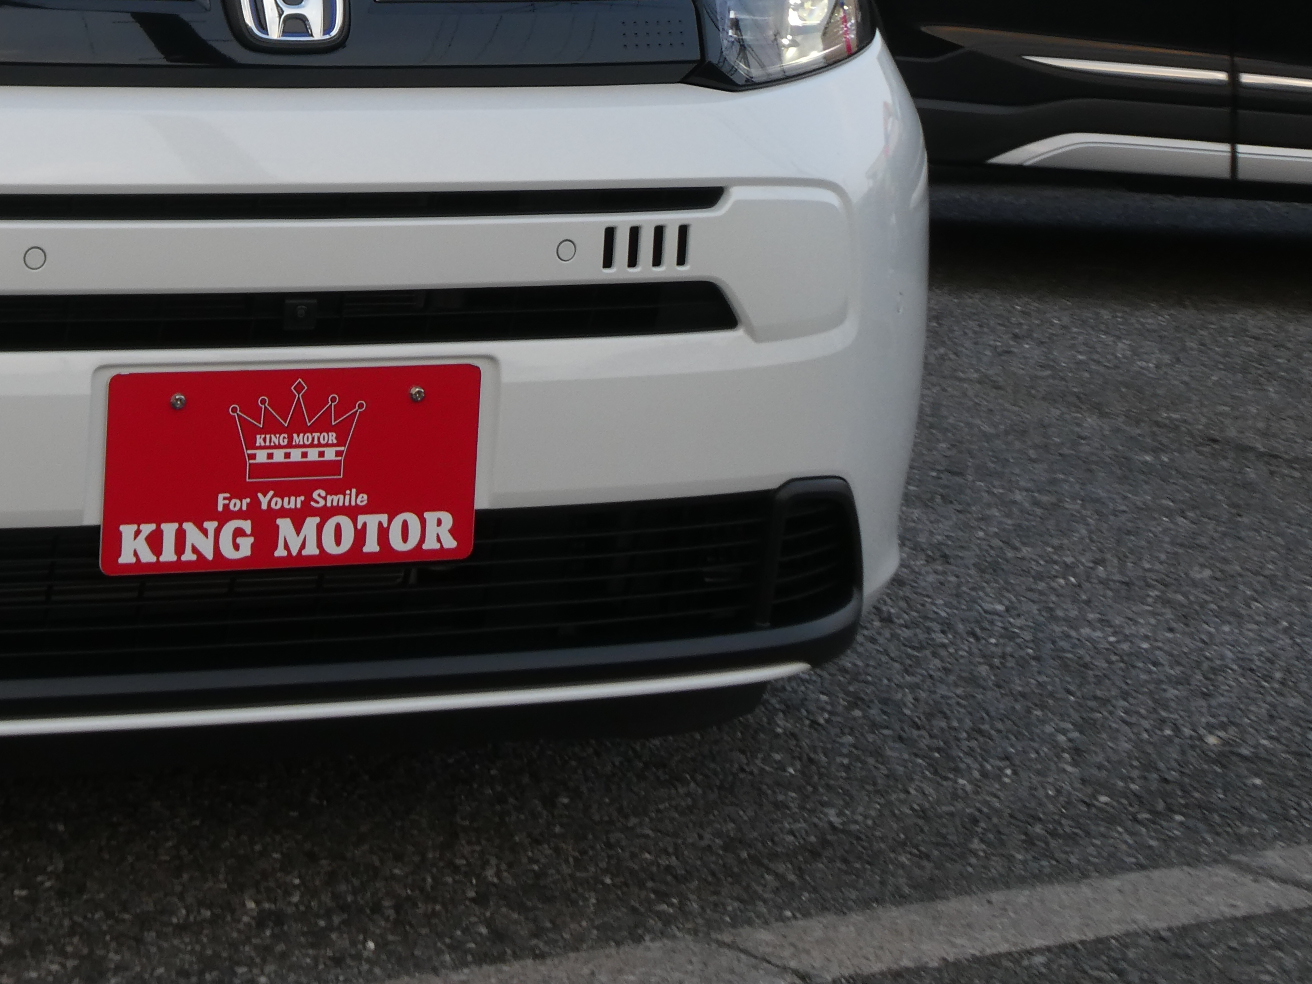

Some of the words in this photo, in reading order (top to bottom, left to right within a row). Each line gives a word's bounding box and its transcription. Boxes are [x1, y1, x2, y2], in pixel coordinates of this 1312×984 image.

[255, 433, 288, 447] KING
[292, 431, 337, 445] MOTOR
[217, 493, 251, 512] For
[257, 489, 305, 511] Your
[310, 488, 368, 508] Smile
[117, 519, 255, 564] KING
[273, 510, 458, 557] MOTOR
